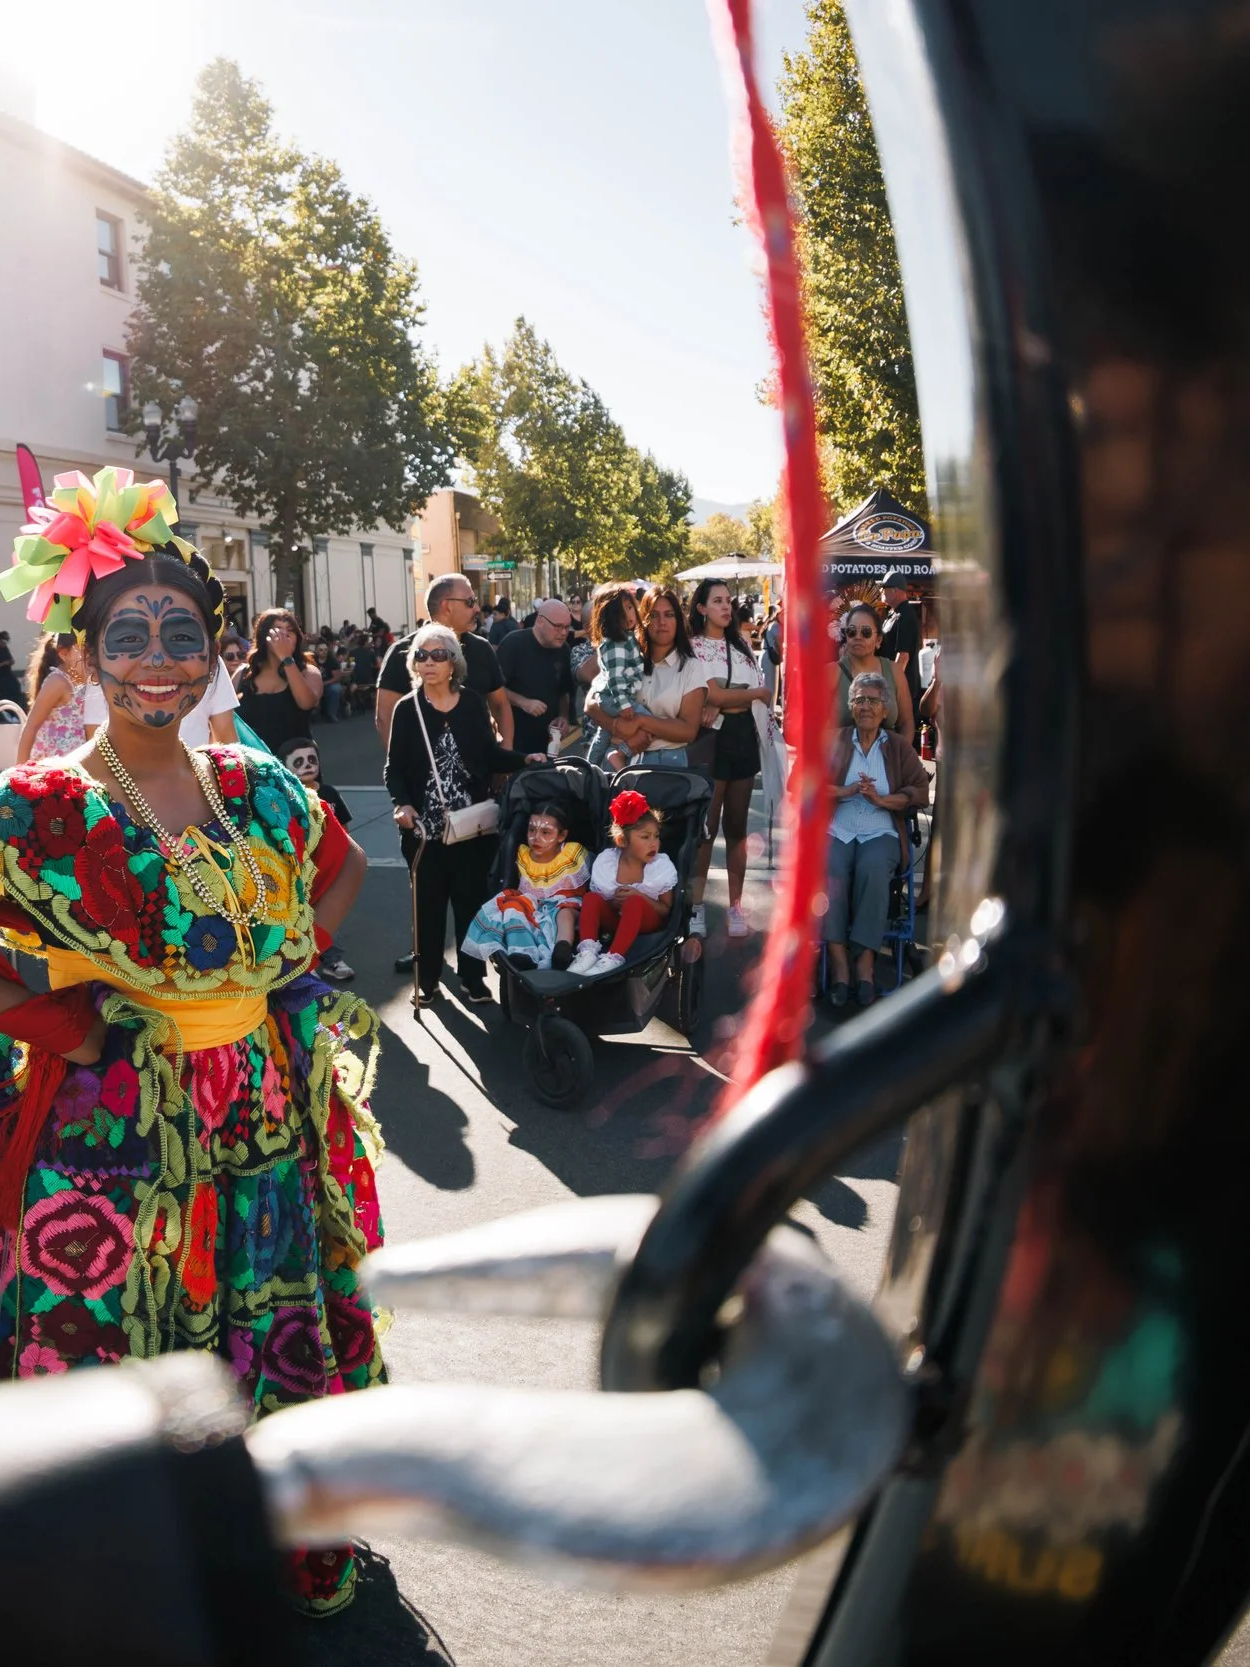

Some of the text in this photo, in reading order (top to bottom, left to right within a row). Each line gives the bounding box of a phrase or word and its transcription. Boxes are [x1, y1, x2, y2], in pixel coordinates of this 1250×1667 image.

[830, 564, 887, 574] POTATOES
[889, 565, 912, 574] AND
[913, 565, 936, 575] ROA
